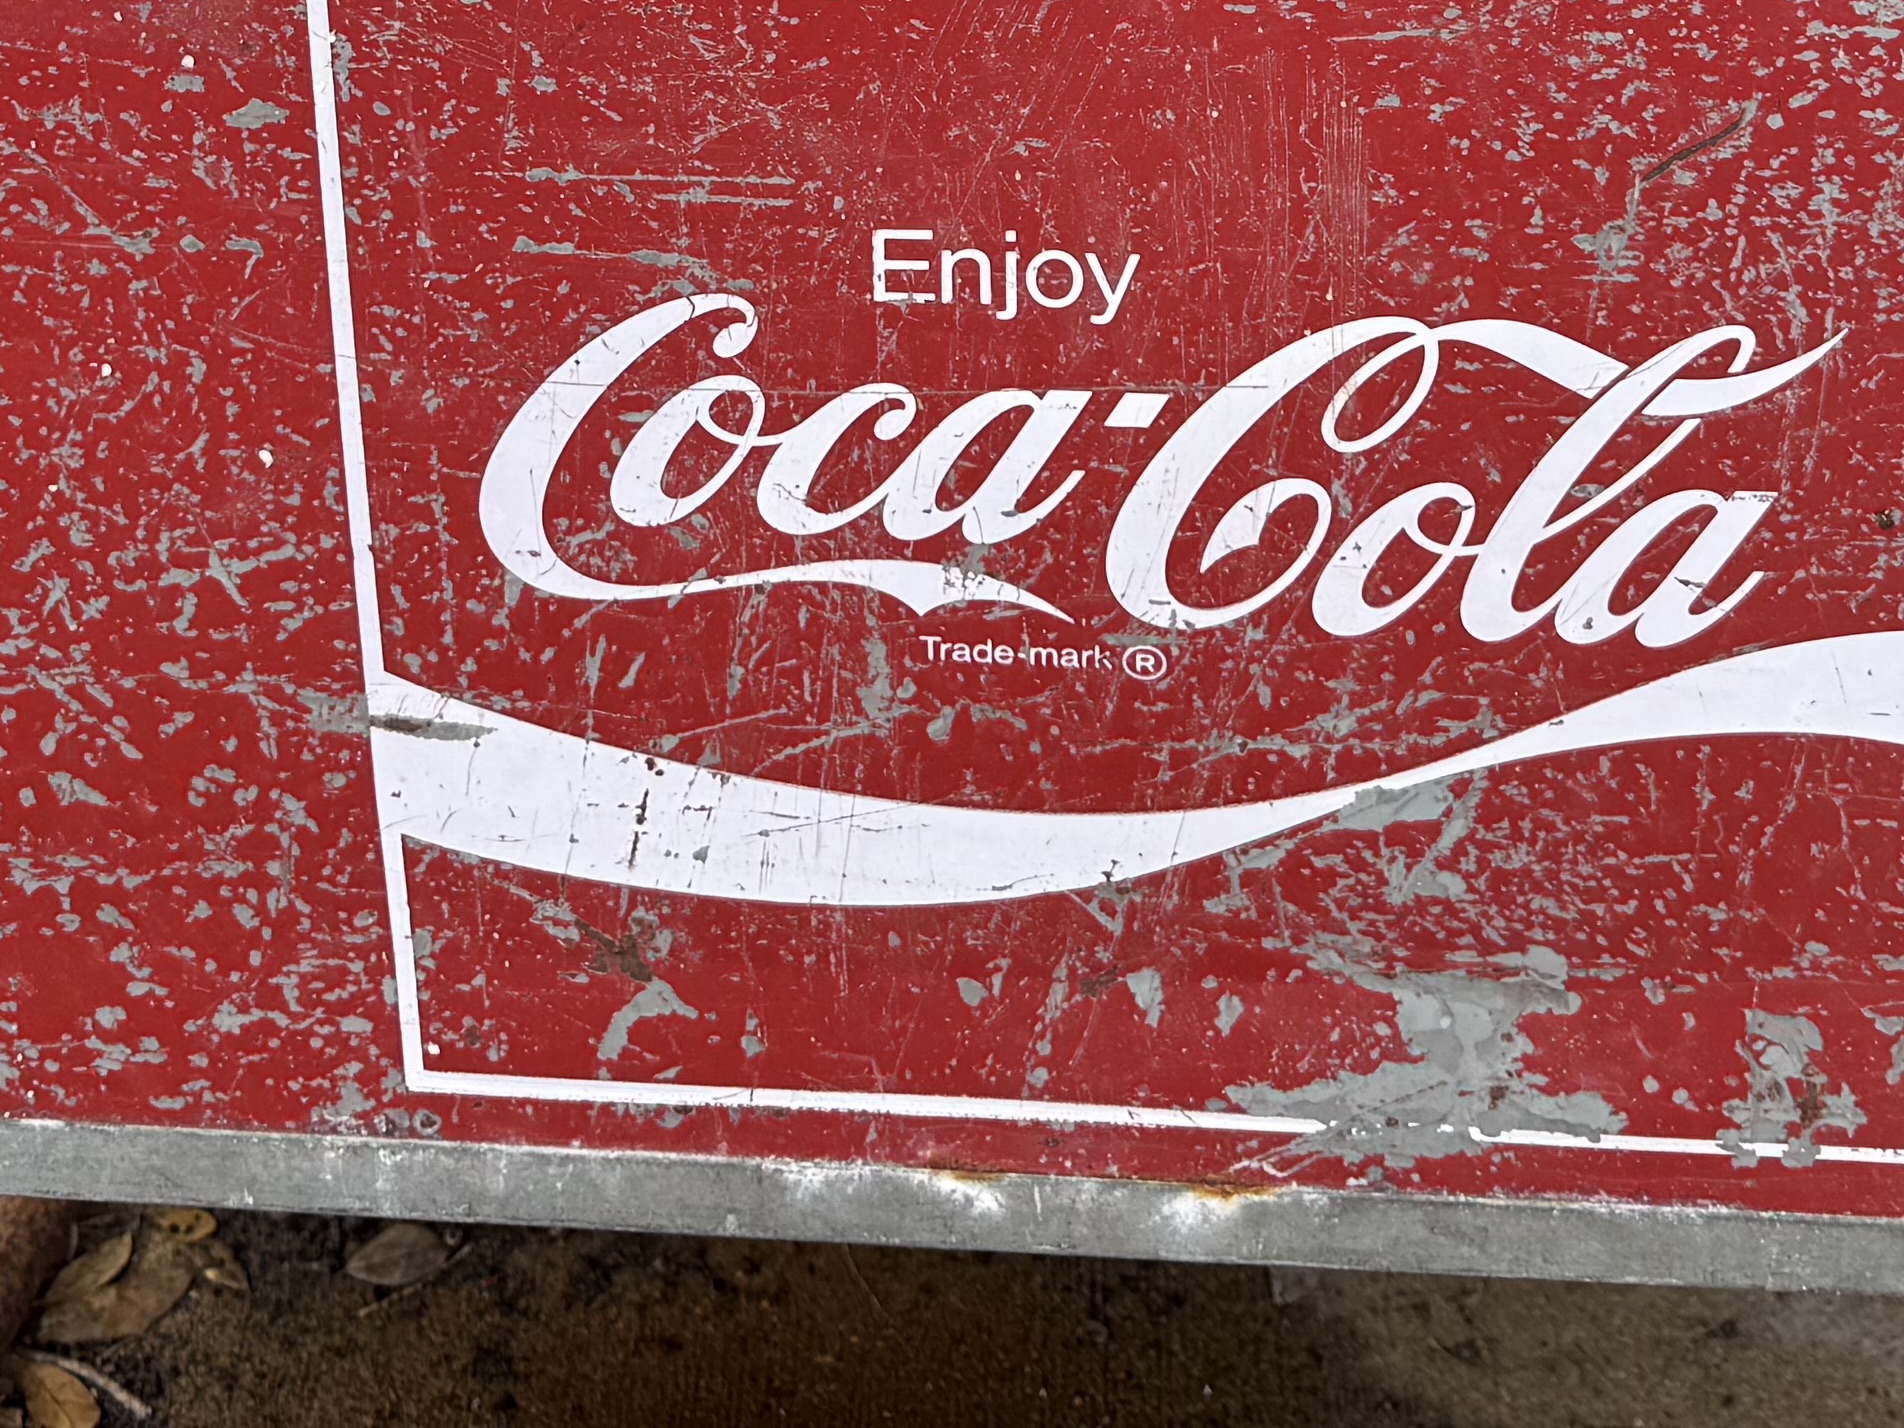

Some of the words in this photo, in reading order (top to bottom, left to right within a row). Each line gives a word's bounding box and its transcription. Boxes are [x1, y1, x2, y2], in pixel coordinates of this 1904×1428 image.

[871, 228, 1141, 325] Enjoy
[478, 291, 1850, 648] Coca-Cola
[918, 635, 1113, 670] Trade-mark
